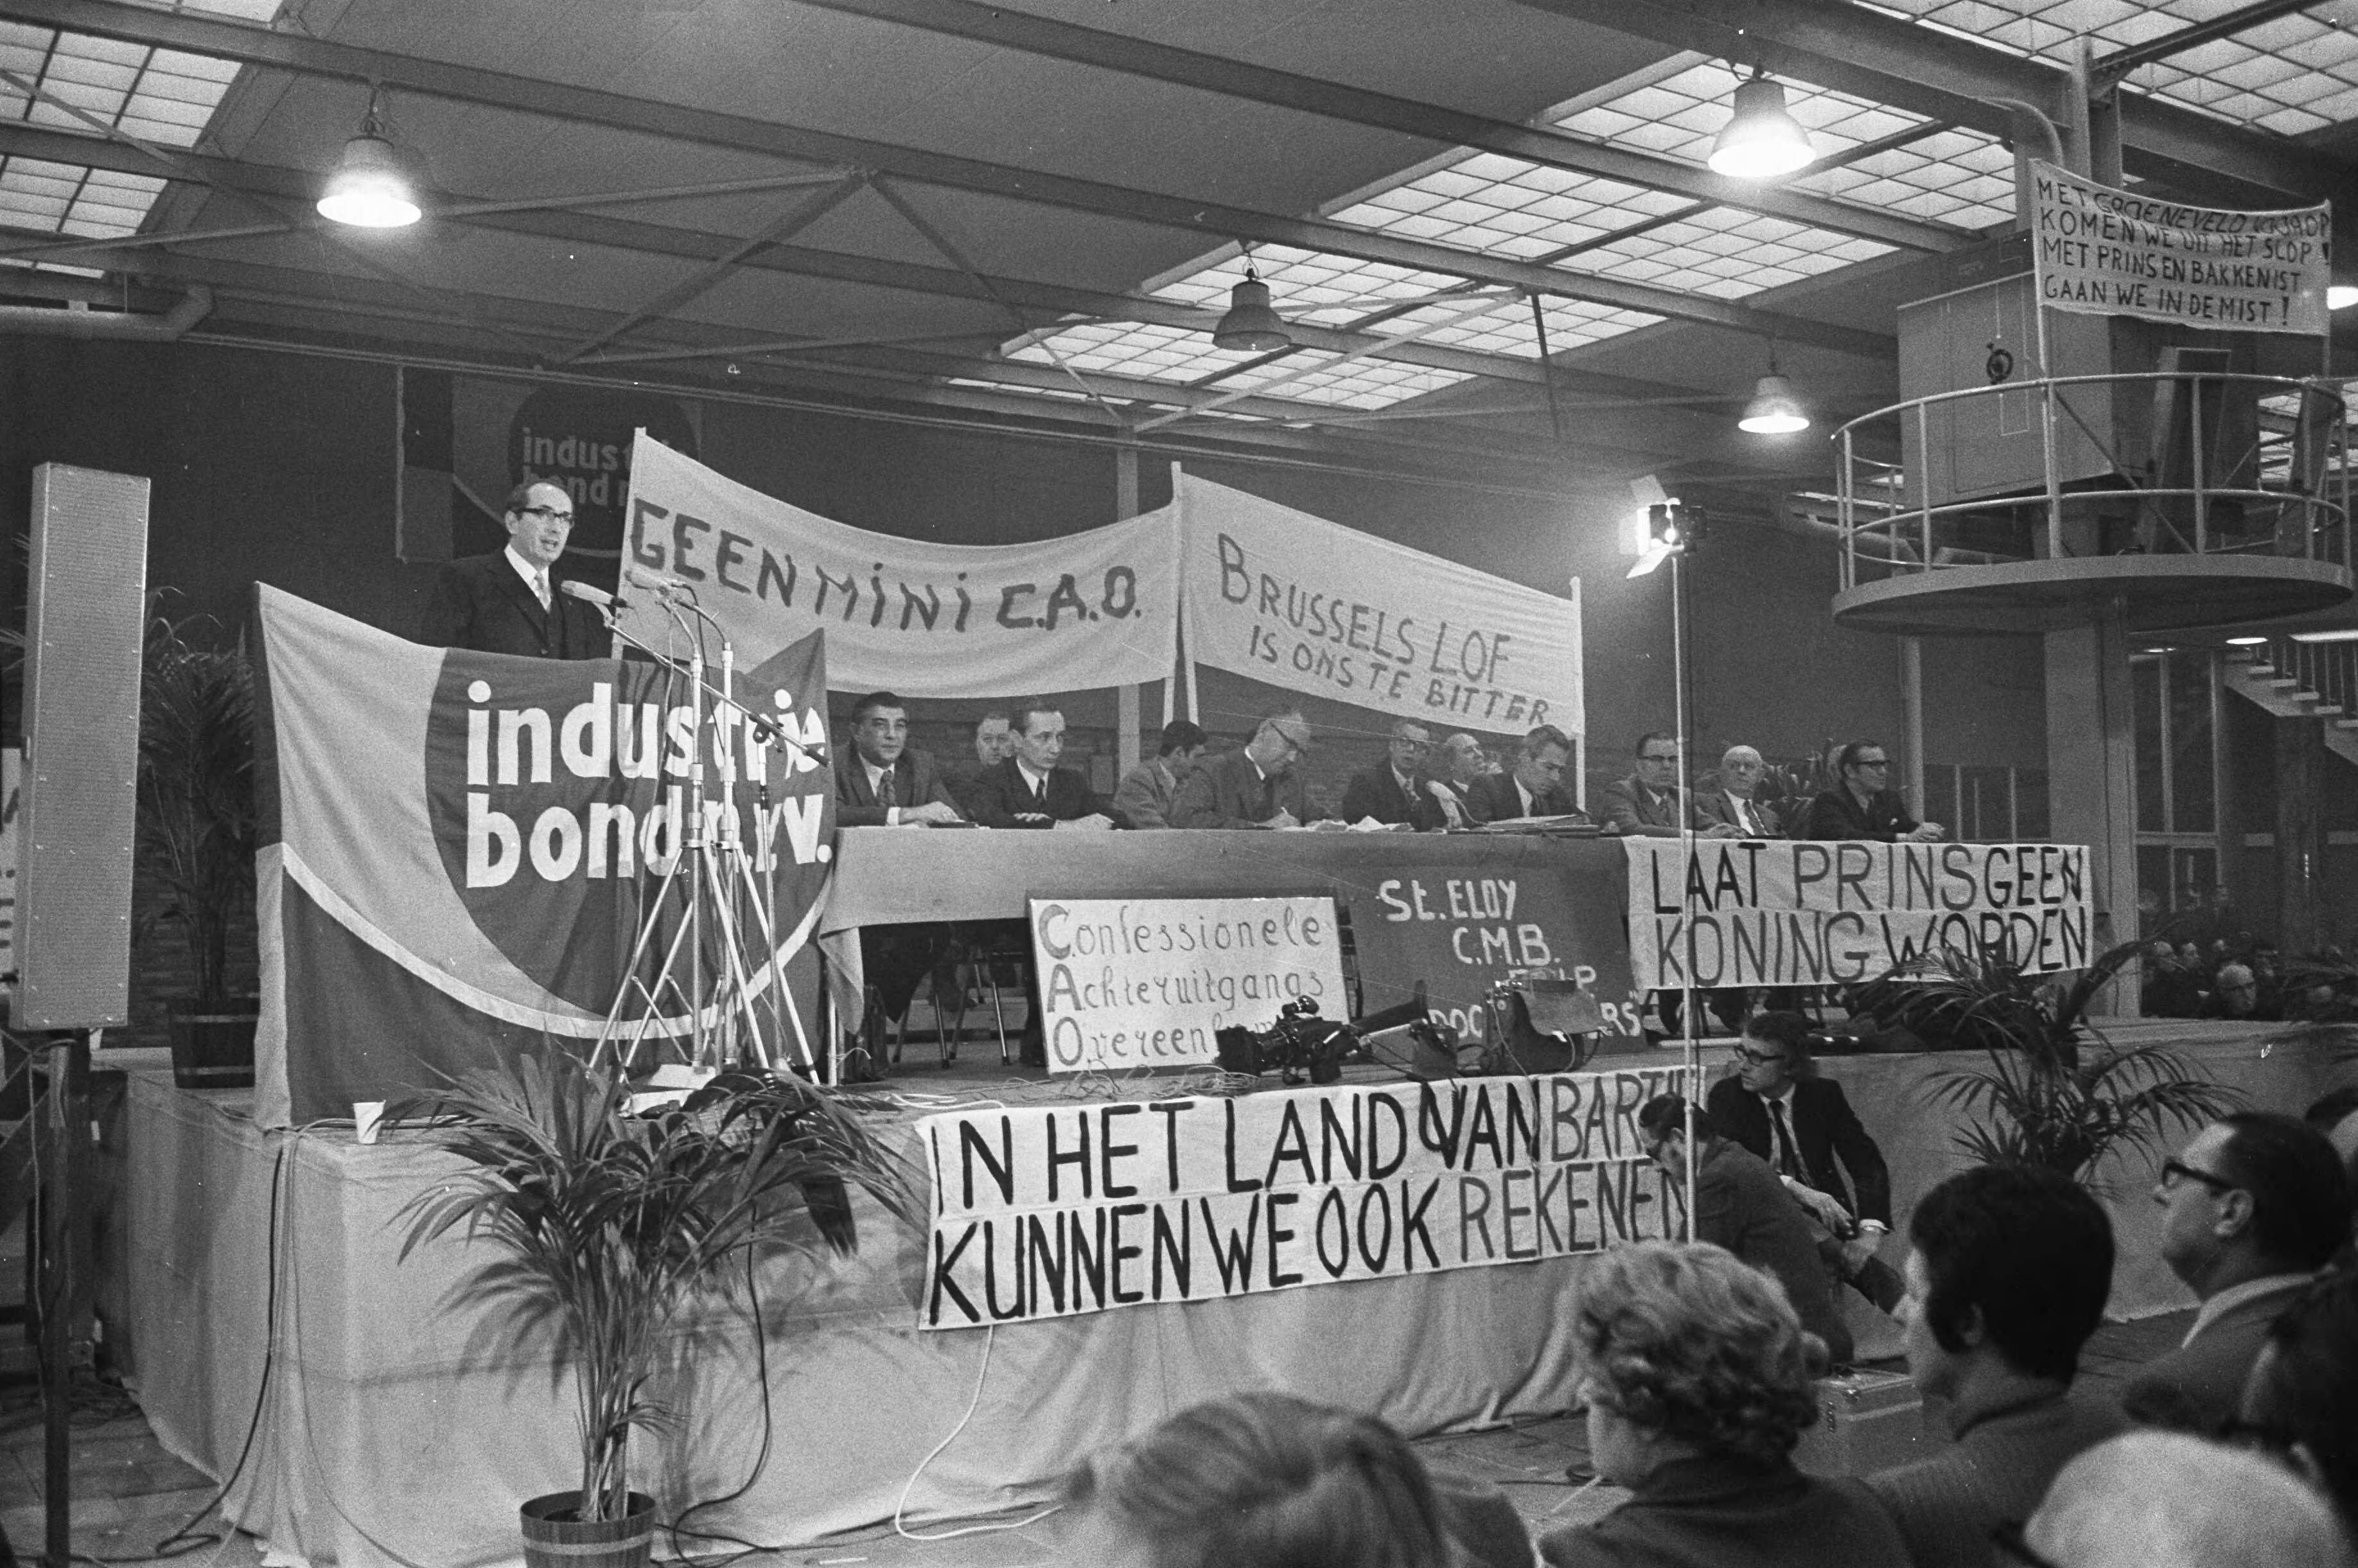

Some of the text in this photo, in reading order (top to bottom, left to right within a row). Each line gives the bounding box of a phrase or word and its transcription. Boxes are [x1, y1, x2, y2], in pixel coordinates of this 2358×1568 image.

[2037, 177, 2087, 207] MET
[2041, 207, 2134, 243] KOMEN
[2141, 224, 2174, 248] WE
[2181, 230, 2208, 252] UIT
[2221, 235, 2257, 258] HET
[2043, 238, 2090, 269] MET
[2192, 260, 2301, 292] BAKKENIST
[2045, 274, 2106, 303] GAAN
[2116, 283, 2148, 307] WE
[2159, 288, 2182, 313] IN
[2189, 294, 2213, 319] DE
[631, 497, 796, 607] GEEN
[996, 565, 1141, 630] C.A.O.
[1219, 533, 1511, 683] BRUSSELS LOF
[1250, 624, 1549, 725] IS ONS TE BITTER
[468, 680, 827, 785] industrie
[467, 784, 682, 888] bond
[1447, 879, 1517, 920] ELOY
[1652, 842, 2082, 913] LAAT PRINS GEEN
[1452, 924, 1560, 965] C.M.B.
[1657, 911, 1870, 987] KONING
[931, 1116, 1014, 1215] IN
[1047, 1101, 1195, 1202] HET
[1226, 1092, 1407, 1192] LAND
[929, 1199, 1190, 1325] KUNNEN
[1201, 1194, 1303, 1294] WE
[1316, 1178, 1440, 1278] OOK
